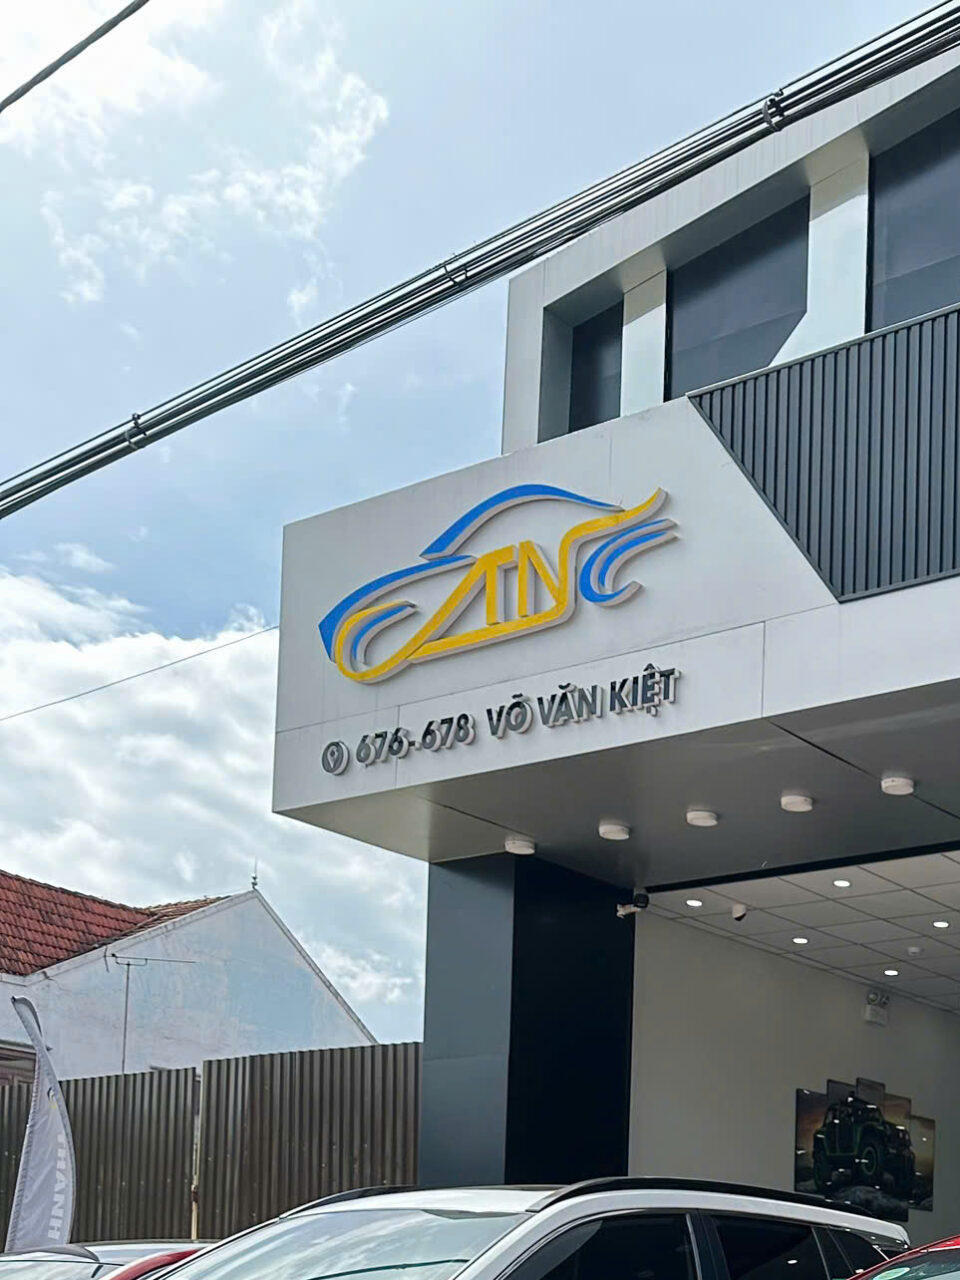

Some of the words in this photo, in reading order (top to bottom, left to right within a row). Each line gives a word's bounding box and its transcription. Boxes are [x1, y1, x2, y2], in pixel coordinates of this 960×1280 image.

[356, 713, 478, 767] 676-678
[487, 693, 534, 738] VÕ
[538, 682, 603, 728] VĂN
[610, 662, 682, 718] KIỆT
